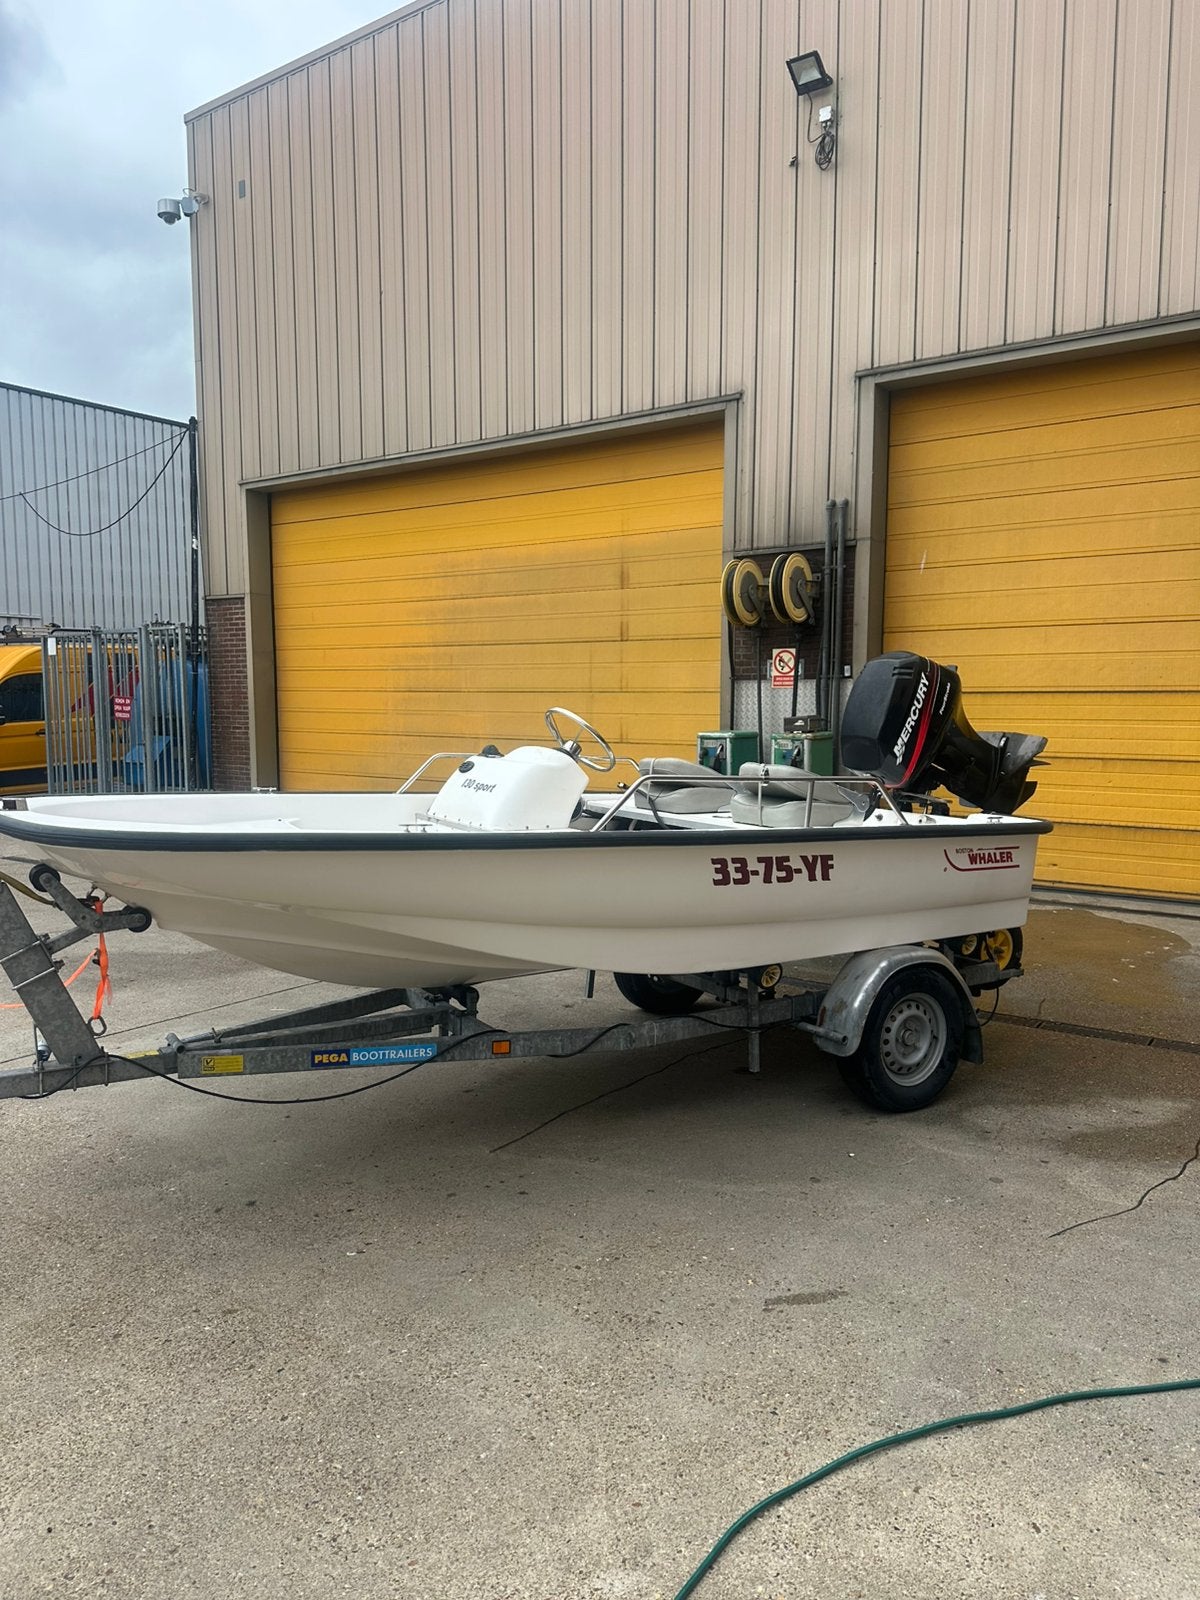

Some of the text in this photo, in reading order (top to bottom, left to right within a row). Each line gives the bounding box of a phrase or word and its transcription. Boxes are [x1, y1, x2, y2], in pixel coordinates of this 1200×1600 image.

[893, 671, 929, 766] MERCURY
[461, 778, 498, 793] 130 sport
[967, 851, 1014, 866] WHALER
[710, 854, 835, 887] 33-75-YF
[314, 1047, 433, 1065] PEGA BOOTTRAILERS
